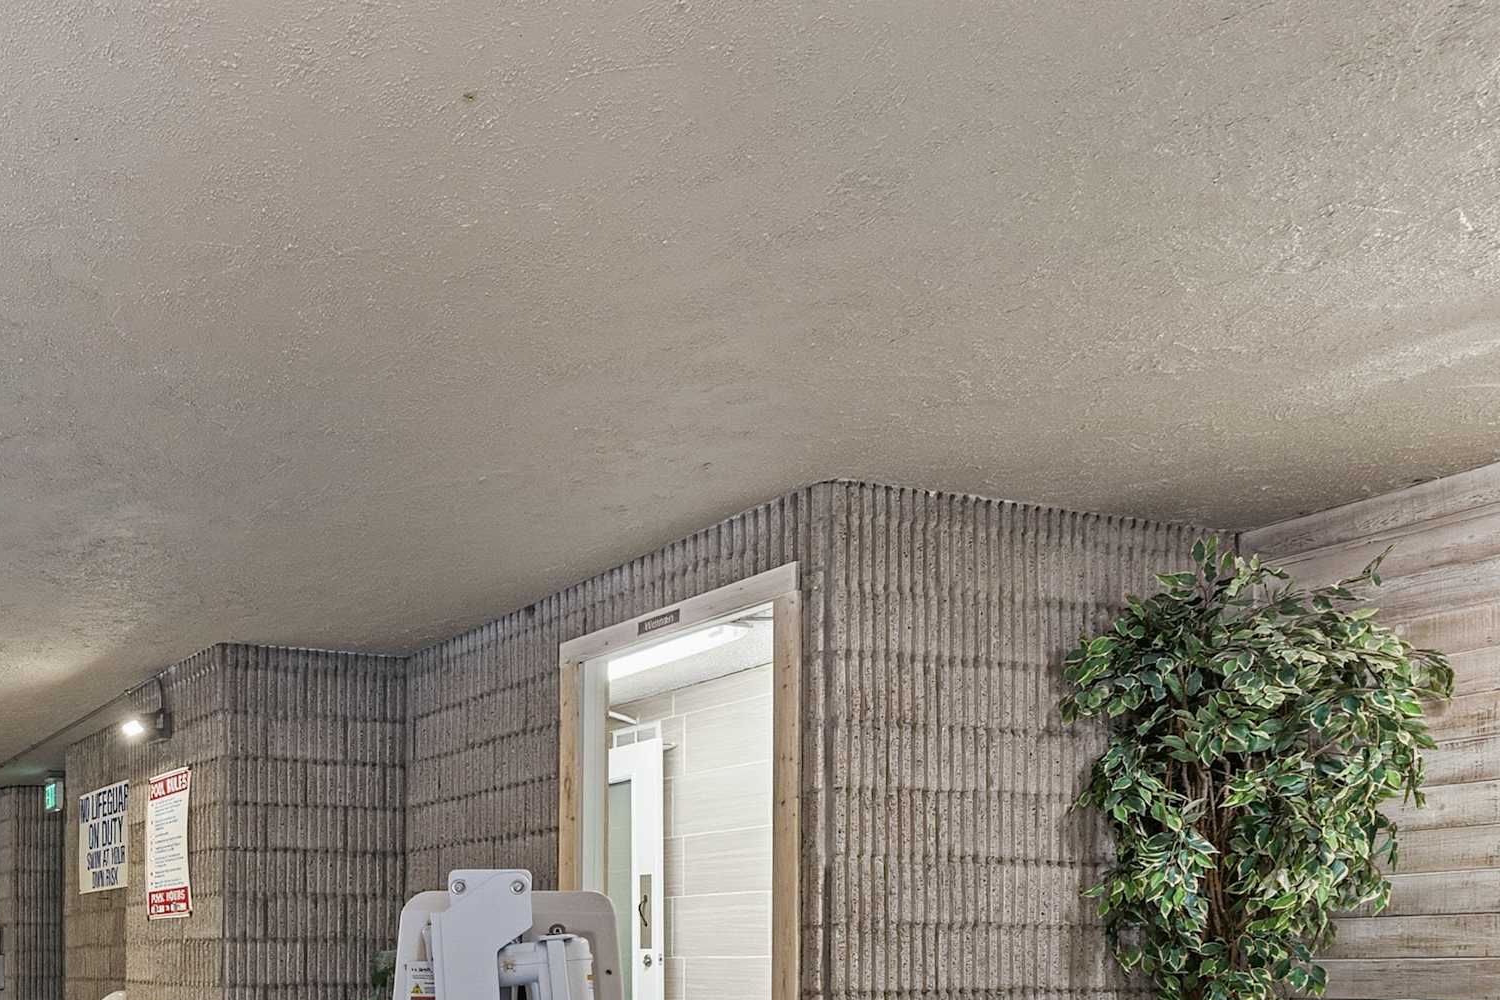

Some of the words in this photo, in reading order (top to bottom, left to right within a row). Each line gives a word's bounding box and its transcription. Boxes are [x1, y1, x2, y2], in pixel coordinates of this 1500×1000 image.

[79, 798, 90, 825] NO
[91, 784, 128, 820] LIFEGUAR
[89, 823, 100, 850] ON
[102, 816, 124, 846] DUTY
[86, 850, 101, 871] SWIM
[103, 848, 110, 867] AT
[105, 866, 119, 887] RISK
